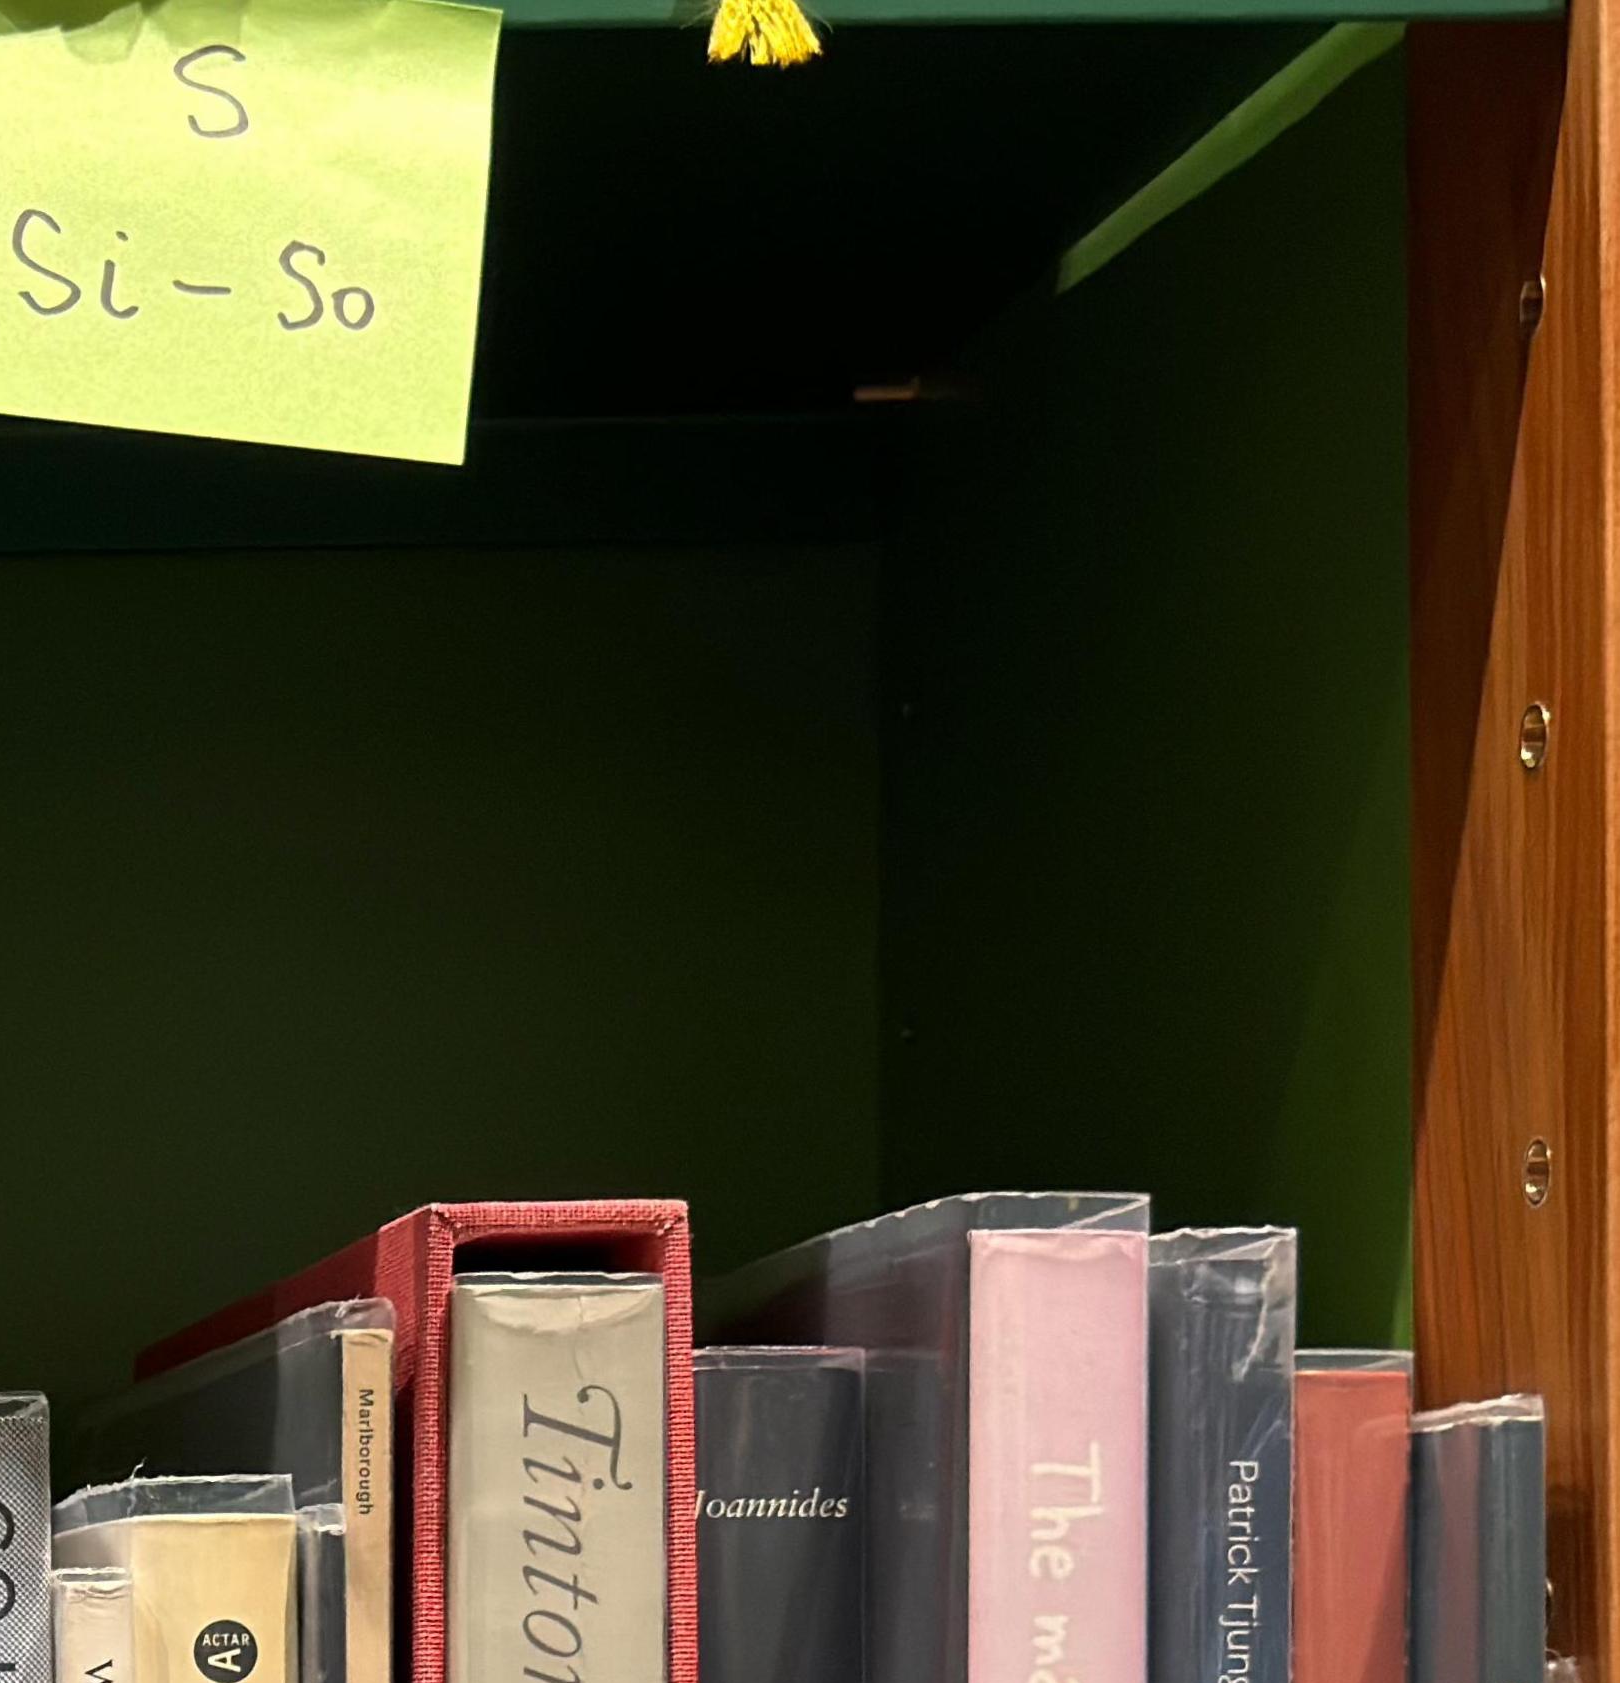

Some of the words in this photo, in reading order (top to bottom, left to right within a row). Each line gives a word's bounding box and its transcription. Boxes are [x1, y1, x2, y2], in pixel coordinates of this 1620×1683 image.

[172, 44, 250, 138] S
[11, 208, 140, 319] Si
[276, 240, 376, 331] So
[353, 1389, 375, 1516] Marlborough
[1027, 1438, 1104, 1581] The
[1225, 1459, 1258, 1585] Patrick
[202, 1633, 250, 1647] ACTAR
